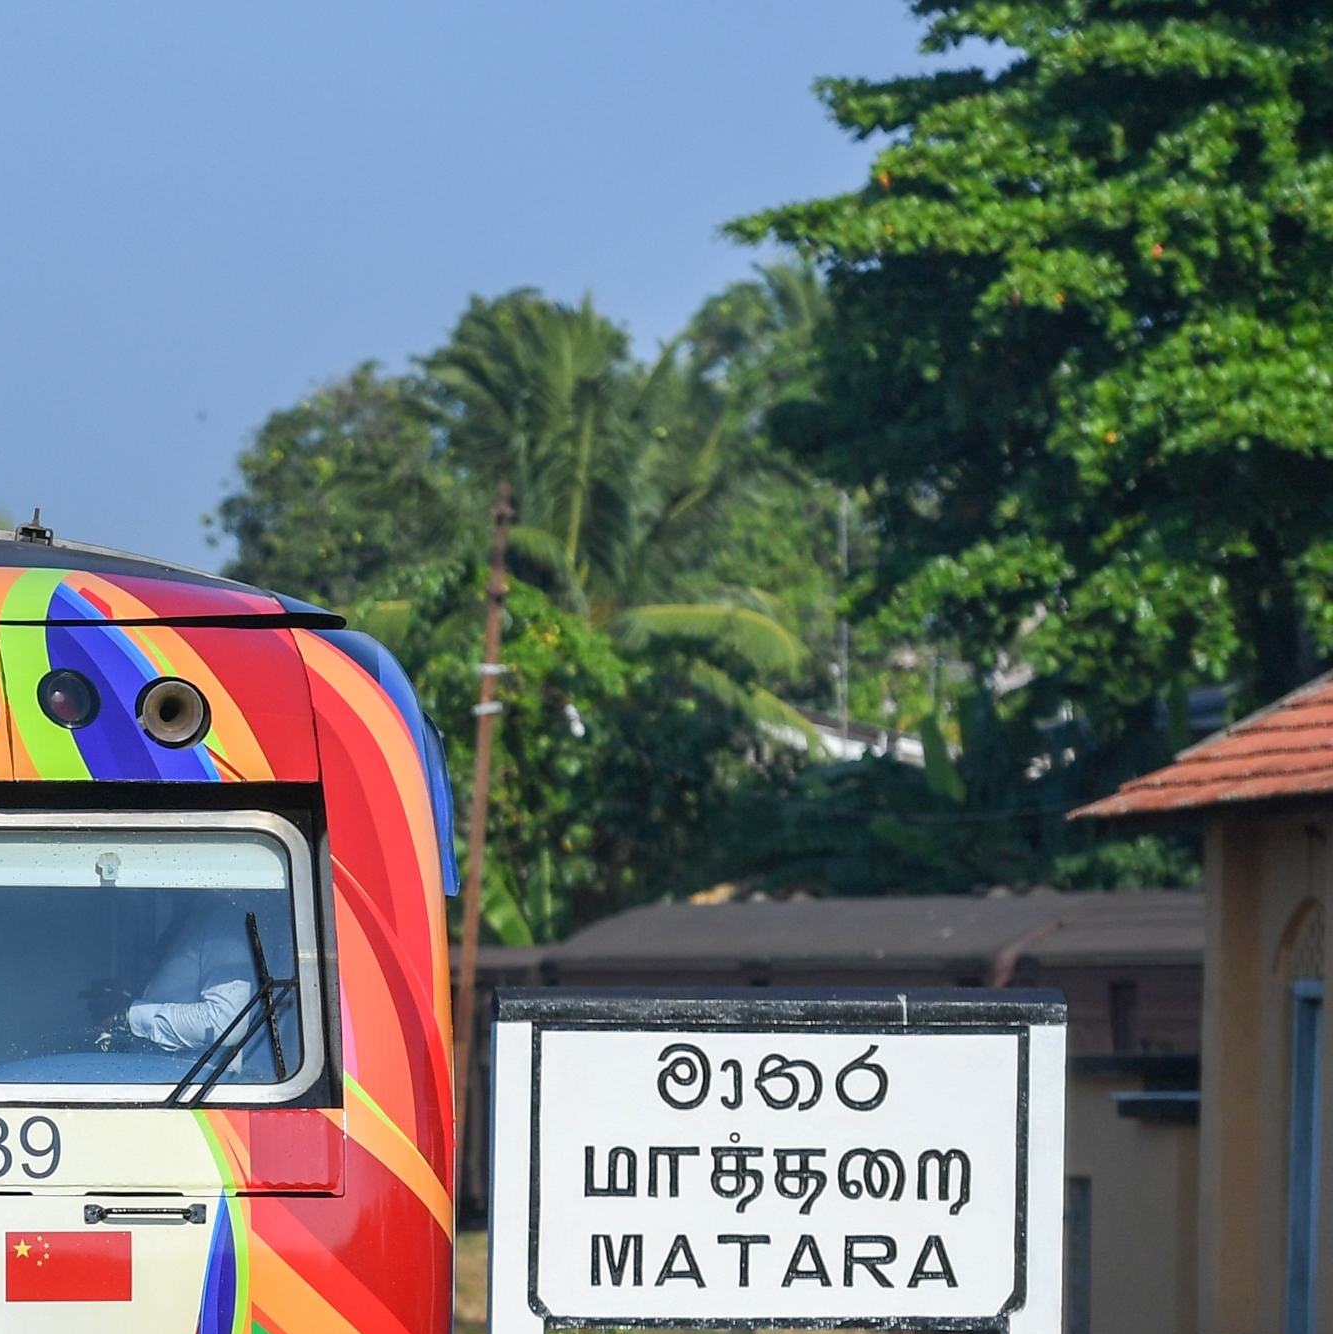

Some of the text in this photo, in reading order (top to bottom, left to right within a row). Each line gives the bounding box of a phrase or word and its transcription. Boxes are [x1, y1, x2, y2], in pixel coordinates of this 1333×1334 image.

[657, 1042, 889, 1111] මාතර
[583, 1132, 972, 1216] மாத்தறை
[590, 1234, 959, 1289] MATARA
